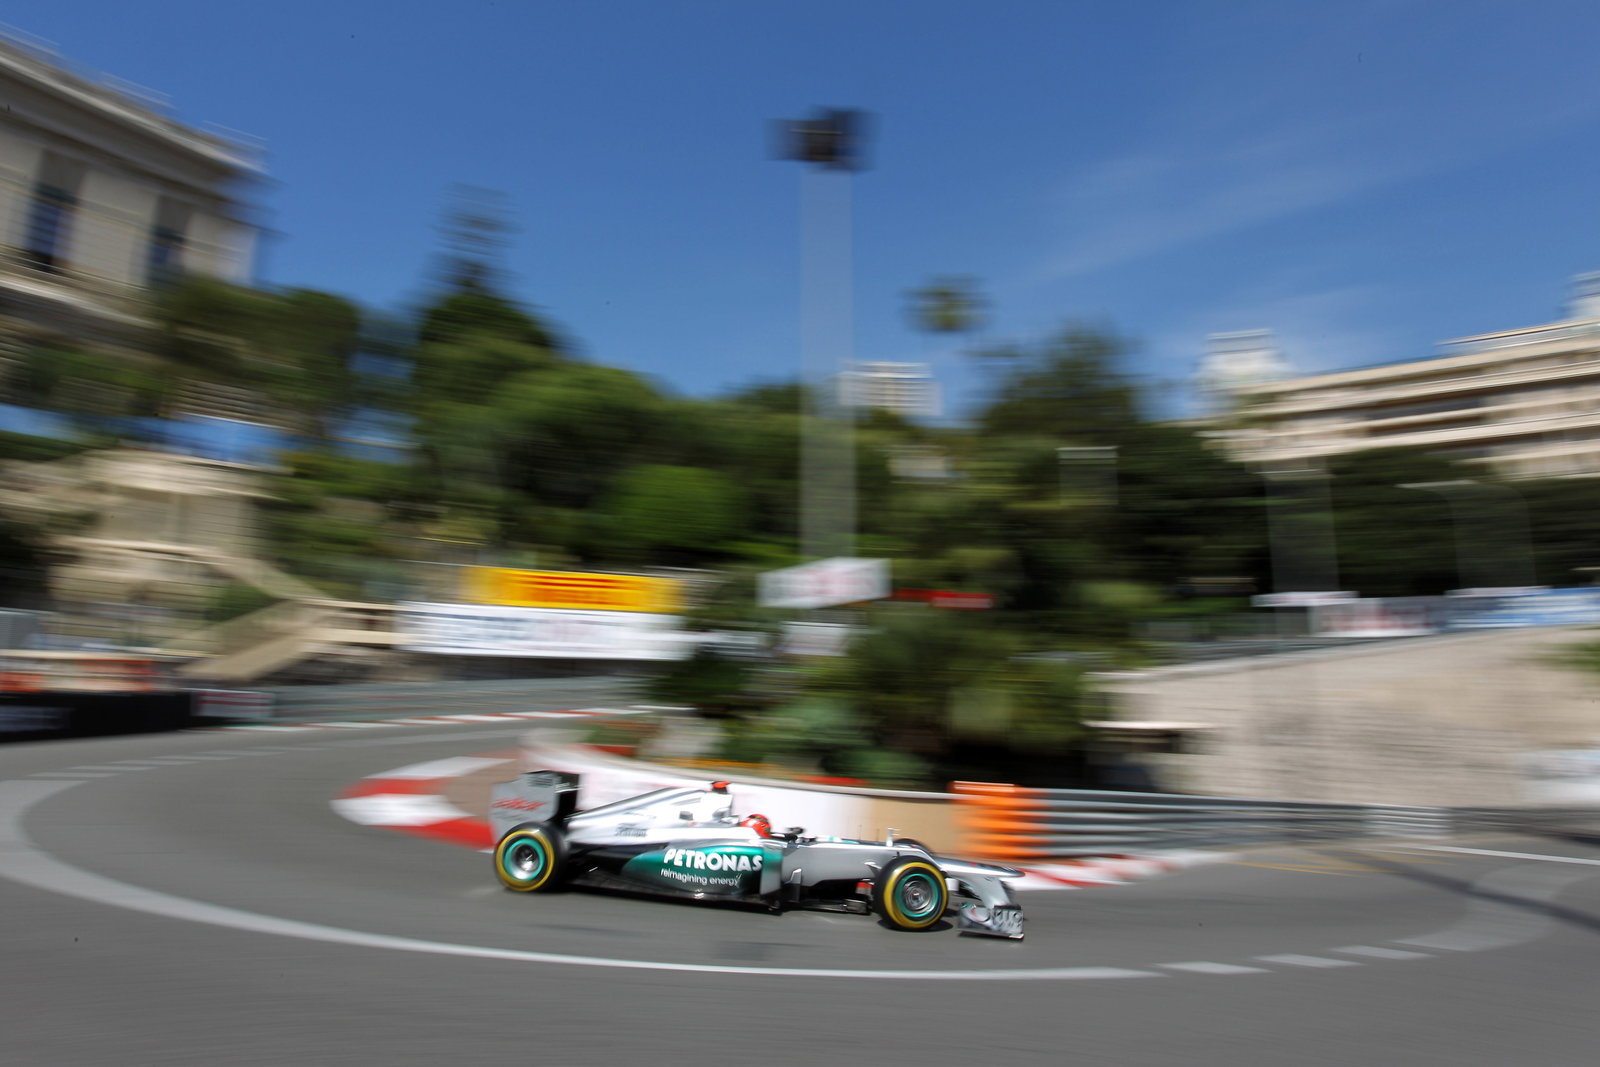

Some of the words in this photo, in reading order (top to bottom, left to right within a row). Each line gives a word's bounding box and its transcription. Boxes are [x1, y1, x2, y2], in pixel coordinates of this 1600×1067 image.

[663, 848, 763, 871] PETRONAS
[661, 868, 708, 886] reimagining
[709, 876, 739, 887] energy
